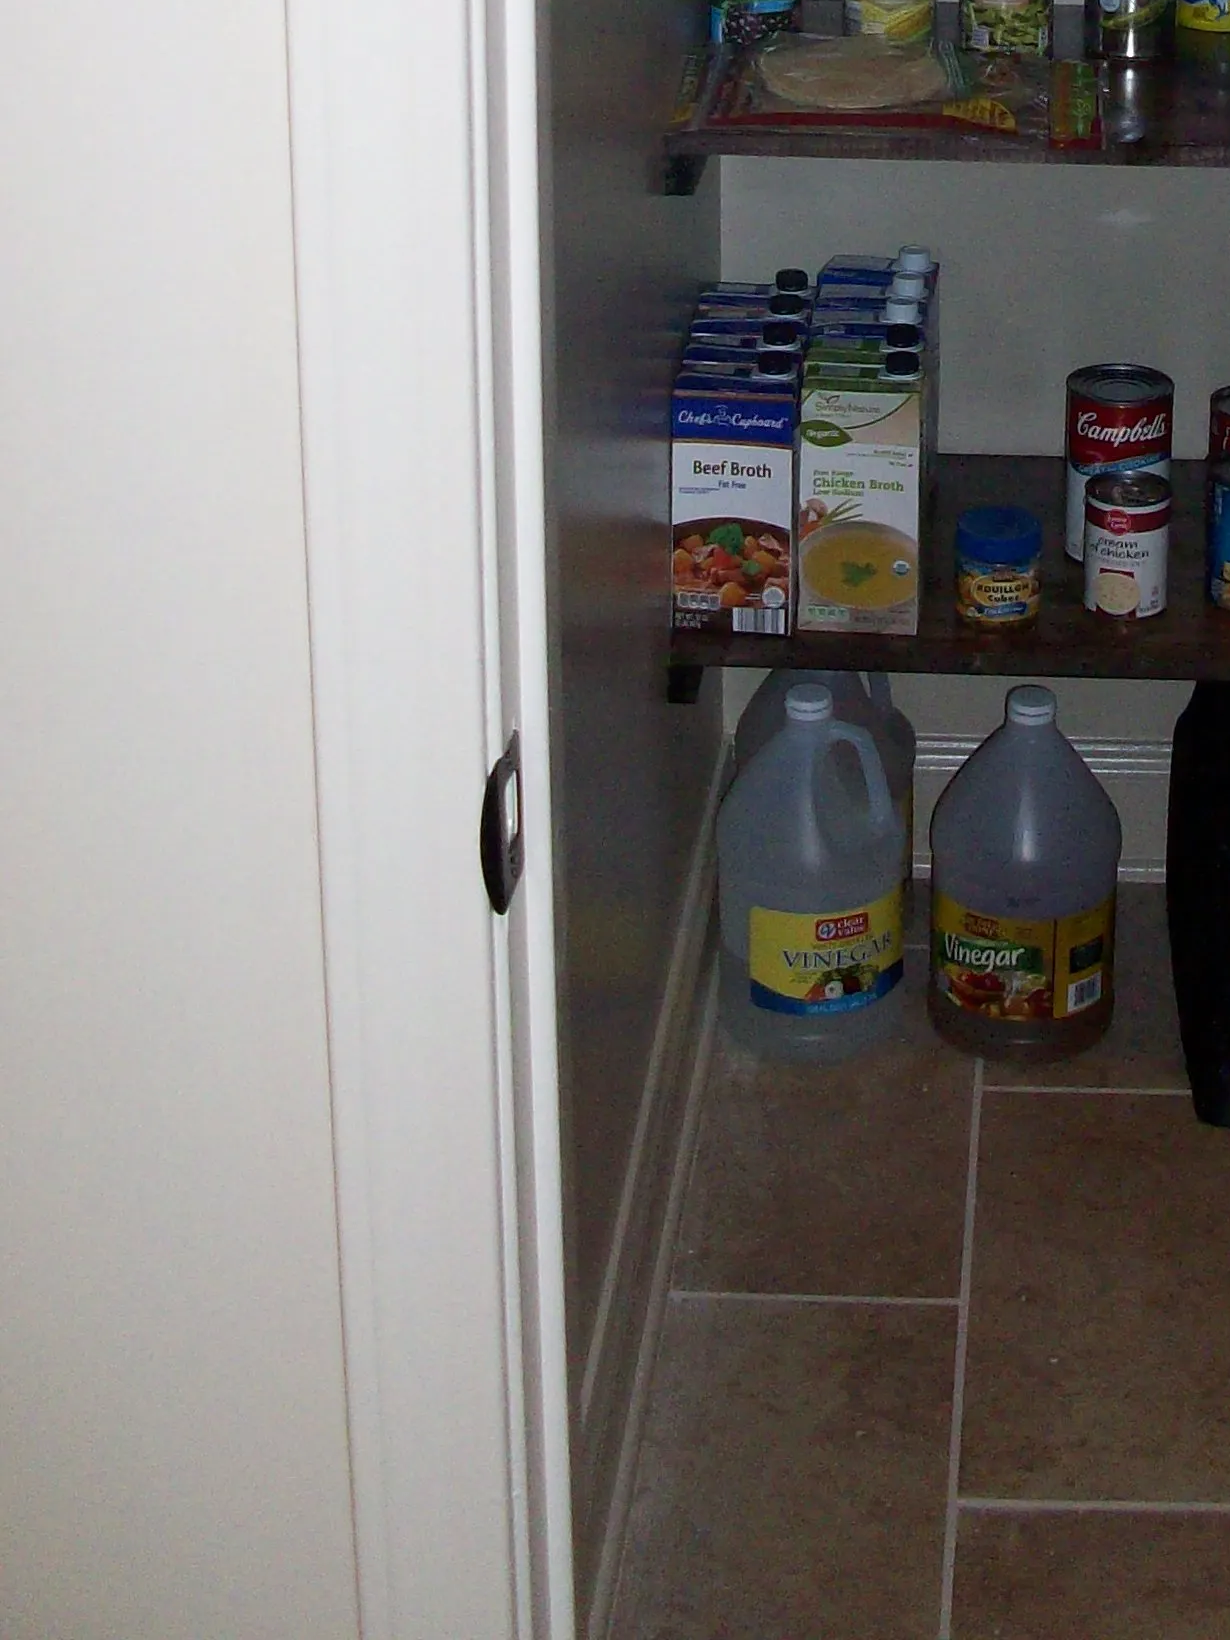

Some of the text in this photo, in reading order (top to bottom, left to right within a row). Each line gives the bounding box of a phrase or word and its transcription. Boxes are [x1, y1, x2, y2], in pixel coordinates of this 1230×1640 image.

[731, 413, 784, 430] Cupboard
[693, 460, 772, 479] Beef Broth
[813, 477, 905, 492] Chicken Broth
[1100, 546, 1150, 559] chicken
[782, 930, 893, 970] VINEGAR
[943, 931, 1026, 974] Vinegar
